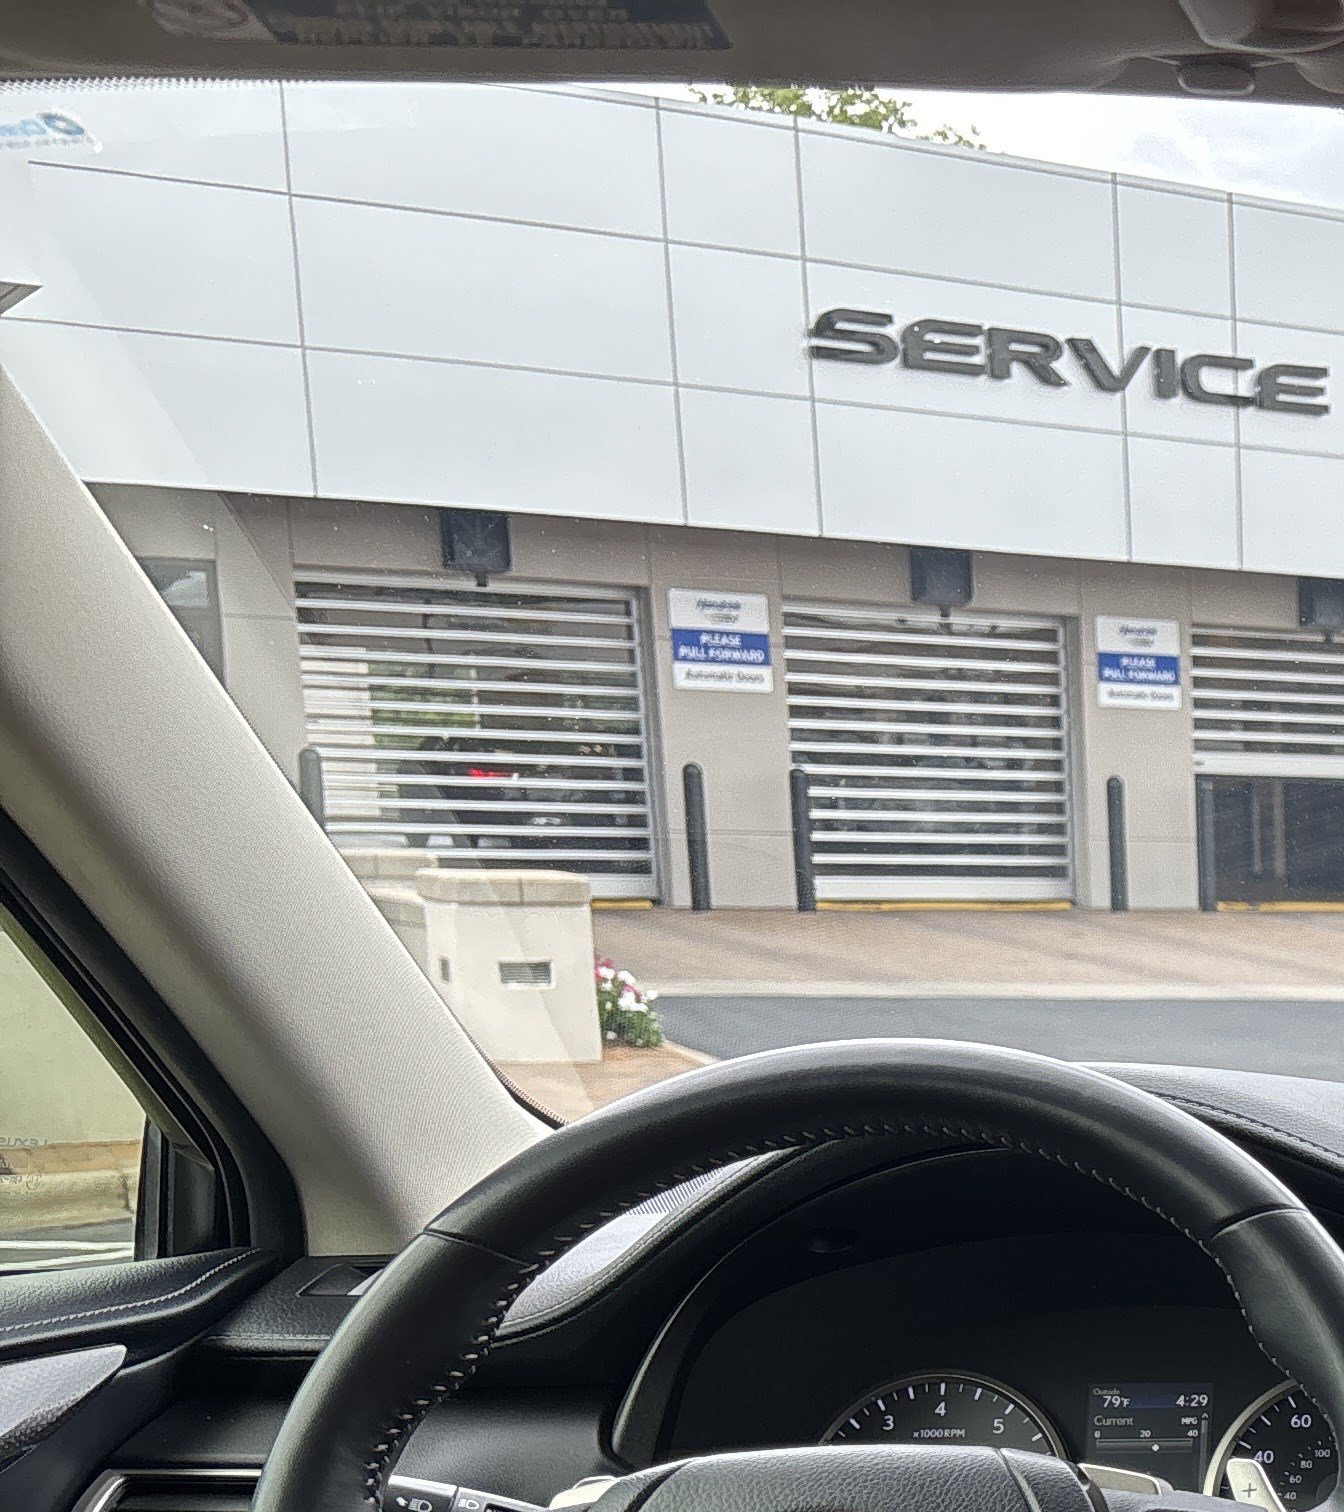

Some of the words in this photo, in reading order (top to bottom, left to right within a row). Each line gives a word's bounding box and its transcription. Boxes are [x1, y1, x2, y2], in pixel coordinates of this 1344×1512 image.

[808, 307, 1331, 416] SERVICE
[1175, 1394, 1208, 1407] 4:29
[935, 1401, 946, 1416] 4
[882, 1415, 894, 1430] 3
[992, 1418, 1005, 1434] 5
[1093, 1415, 1134, 1426] Current
[1290, 1414, 1311, 1428] 60
[1140, 1429, 1151, 1438] 20
[1187, 1429, 1199, 1437] 40
[1254, 1450, 1274, 1464] 40
[1314, 1449, 1331, 1458] 100
[1300, 1460, 1313, 1469] 80
[1289, 1475, 1302, 1483] 60
[1283, 1491, 1297, 1500] 40
